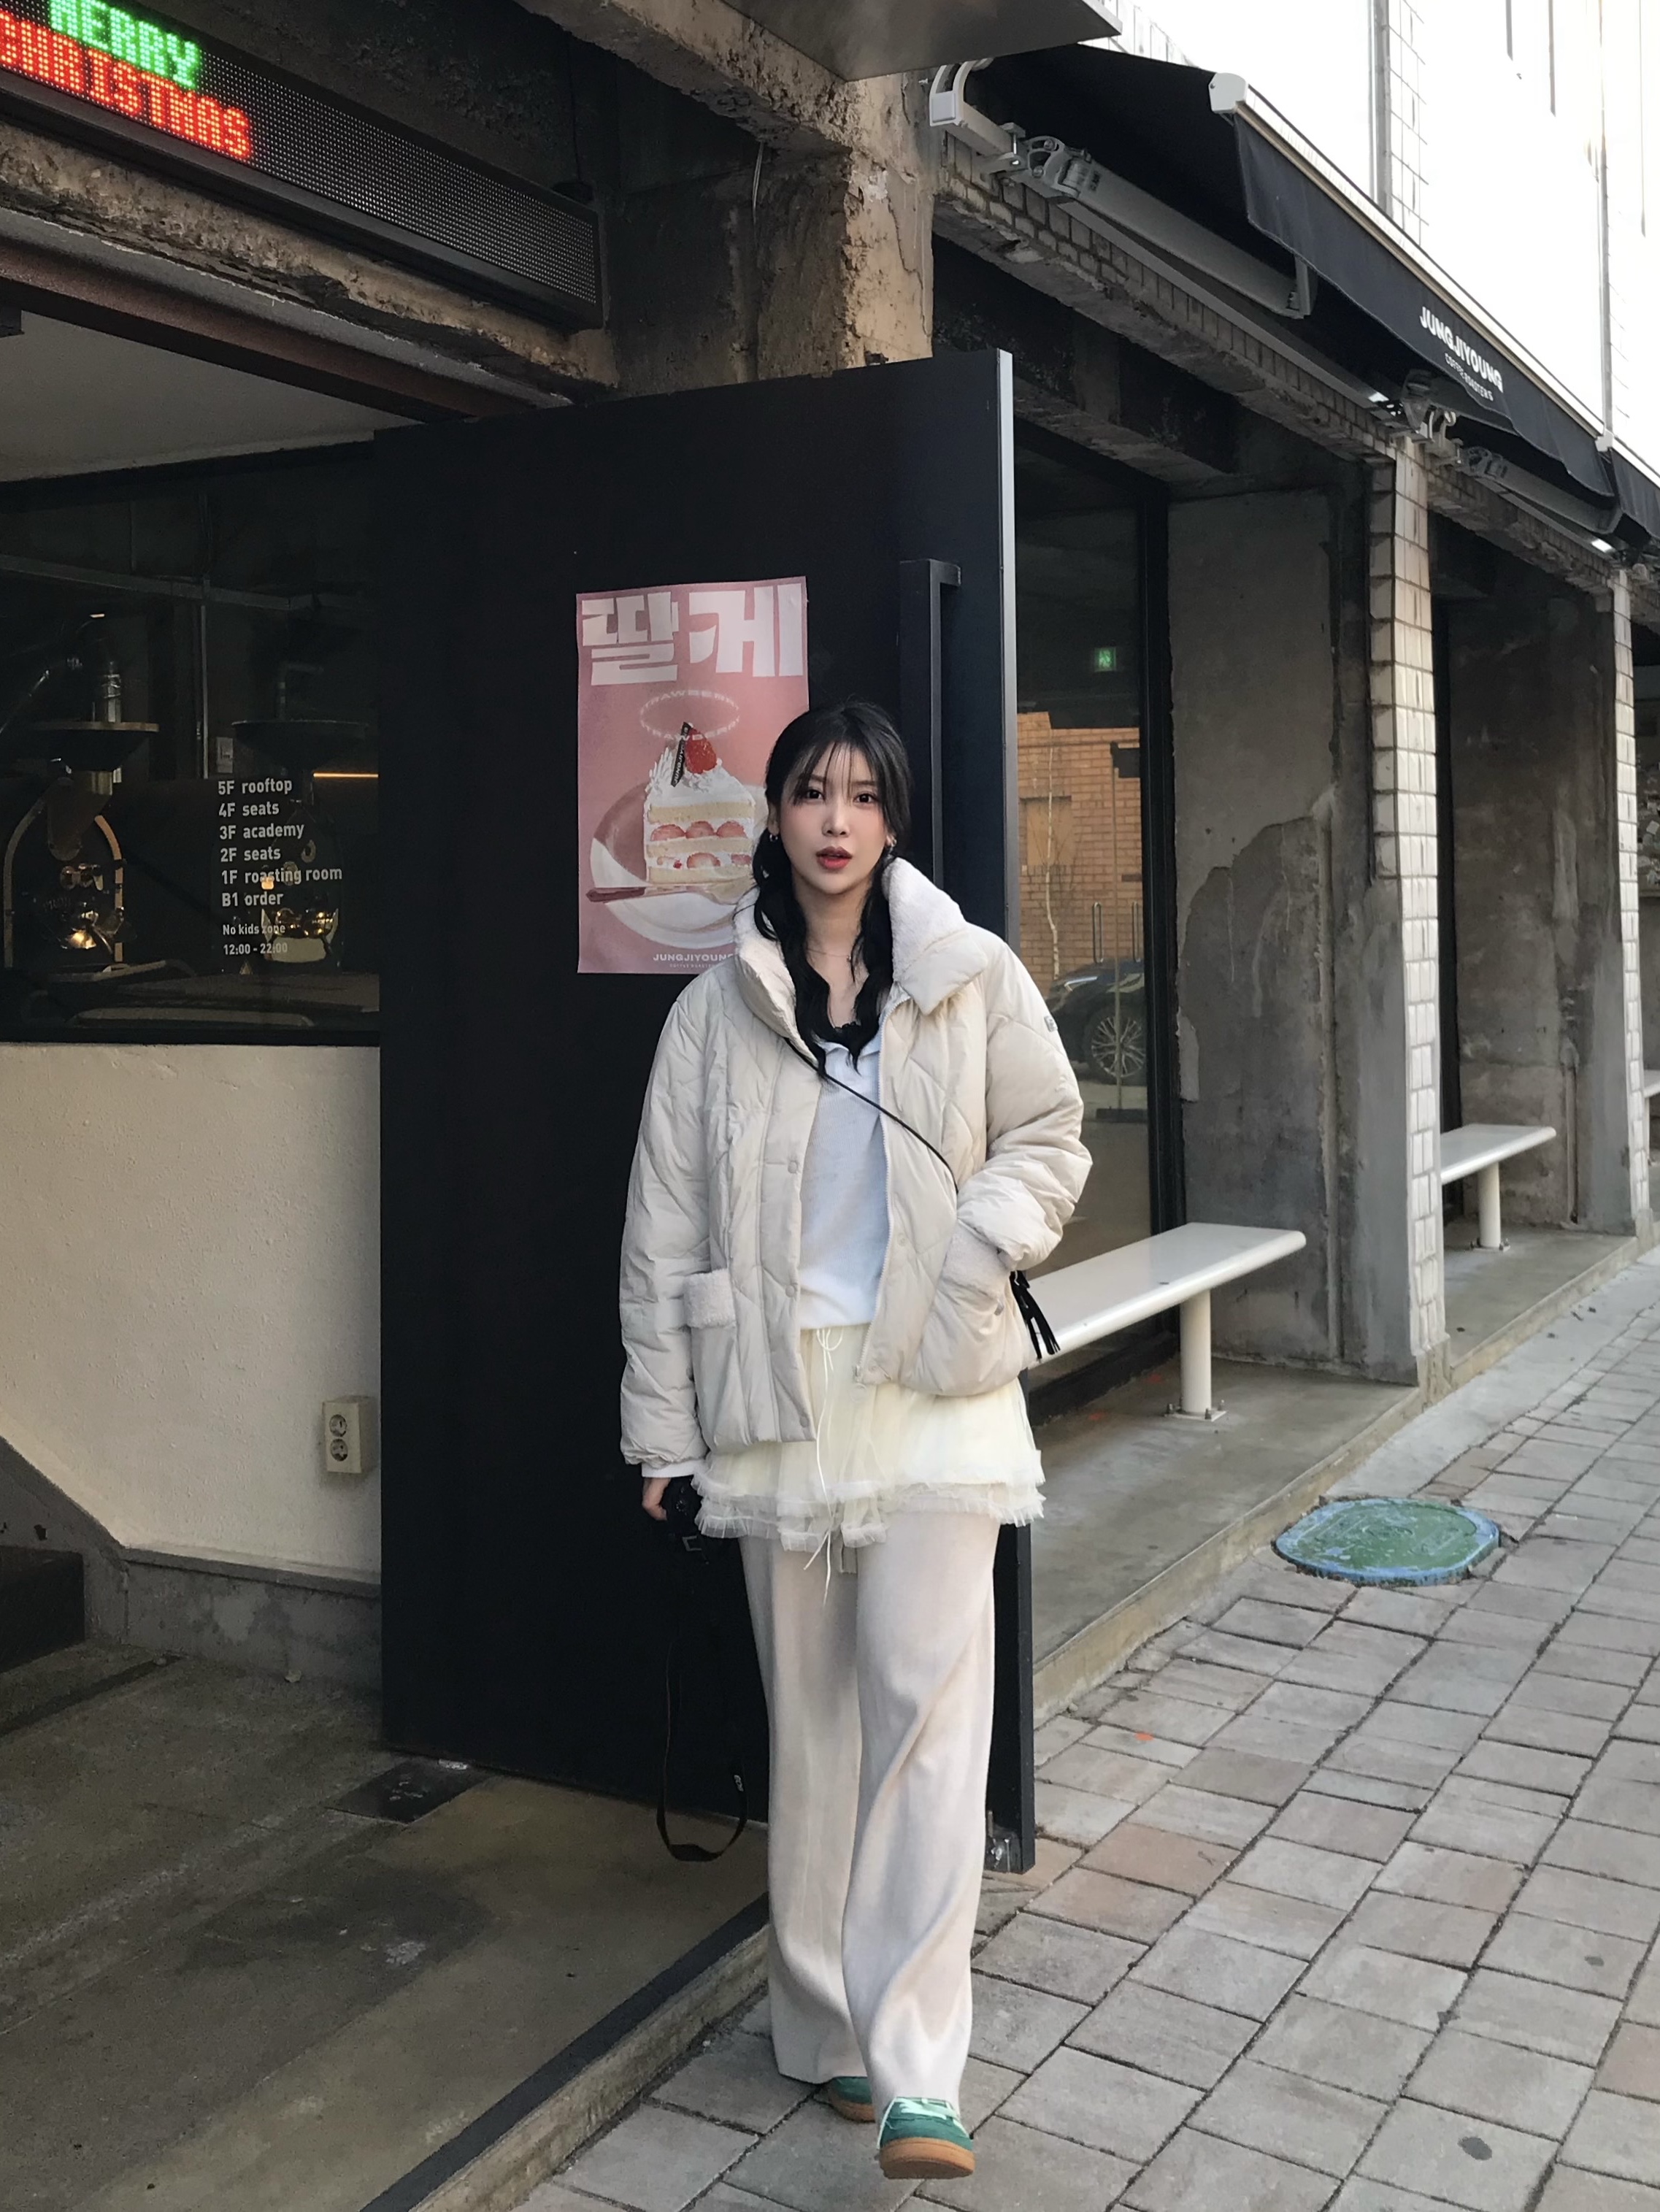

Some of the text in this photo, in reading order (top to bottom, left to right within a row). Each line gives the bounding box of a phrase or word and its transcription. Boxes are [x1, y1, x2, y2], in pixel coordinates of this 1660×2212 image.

[50, 0, 199, 88] MERRY
[1420, 307, 1504, 393] JUNGJIYOUNG
[218, 778, 293, 795] 5F rooftop
[219, 802, 280, 817] 4F seats
[220, 823, 304, 840] 3F academy
[220, 846, 281, 862] 2F seats
[221, 867, 342, 885] 1F roasting room
[222, 891, 284, 907] B1 order
[223, 923, 285, 935] No kids zone
[223, 943, 250, 955] 12:00
[260, 942, 288, 954] 22:00
